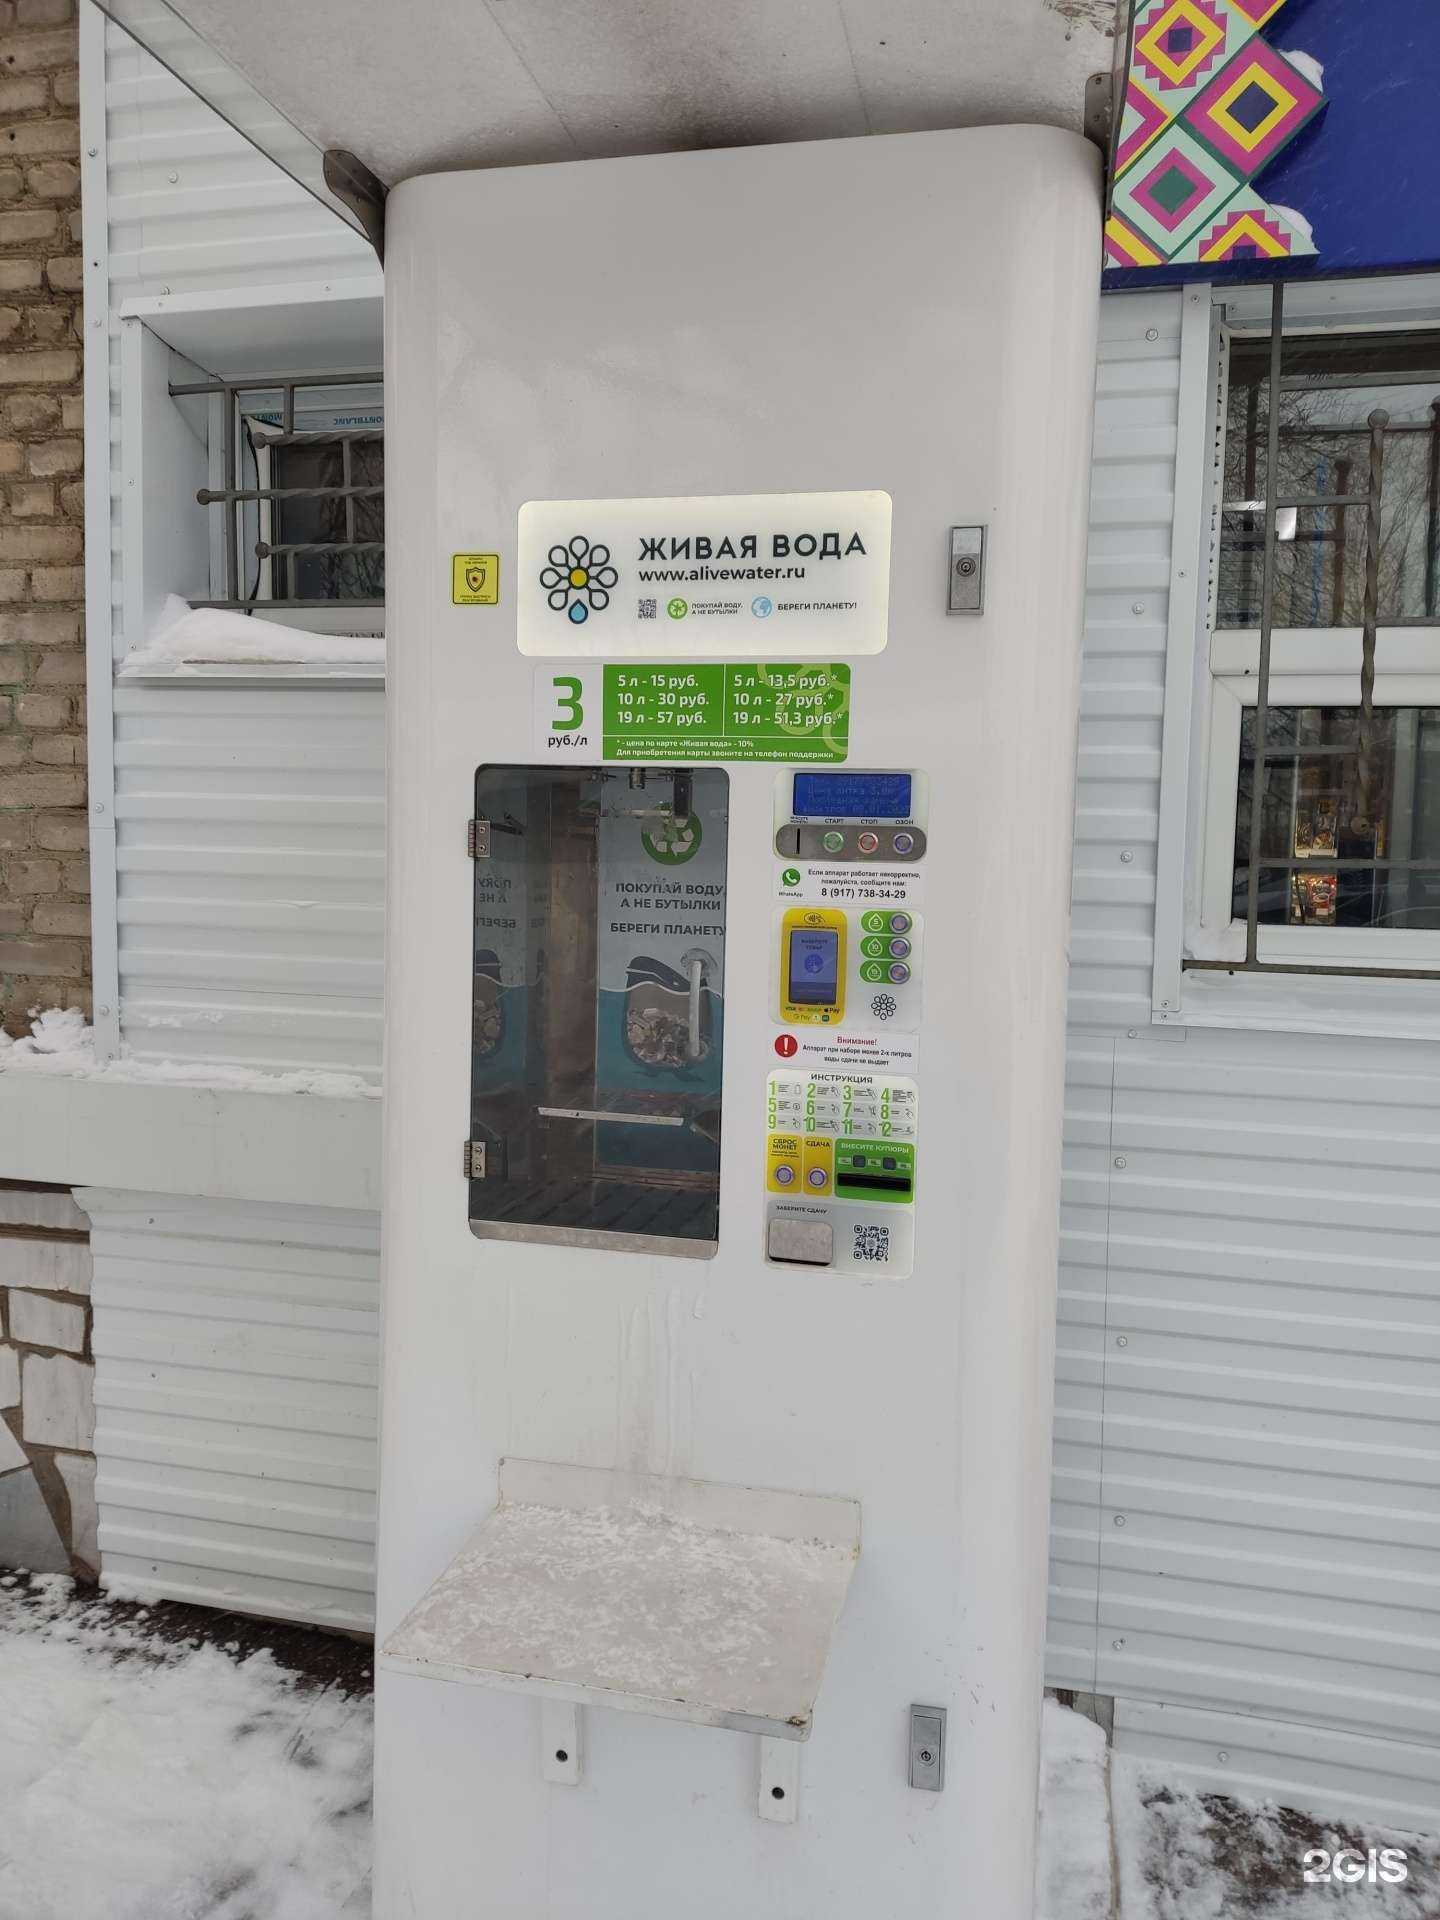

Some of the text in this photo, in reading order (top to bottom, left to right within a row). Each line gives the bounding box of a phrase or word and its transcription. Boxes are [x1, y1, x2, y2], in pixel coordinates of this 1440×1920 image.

[335, 416, 384, 425] ONTBLANC
[638, 532, 867, 561] ЖИВАЯ ВОДА
[638, 565, 805, 582] www.alivewater.ru
[778, 602, 857, 611] БЕРЕГИ ПЛАНЕТУ!
[618, 675, 626, 687] 5
[629, 678, 638, 687] л
[651, 675, 665, 687] 15
[669, 674, 698, 689] руб.
[734, 675, 742, 686] 5
[746, 677, 755, 686] л
[768, 675, 796, 688] 13,5
[552, 676, 584, 730] 3
[618, 693, 633, 705] 10
[637, 696, 645, 705] л
[658, 693, 675, 705] 30
[680, 693, 709, 708] руб.
[734, 693, 749, 705] 10
[753, 696, 761, 705] л
[775, 693, 792, 705] 27
[618, 712, 632, 723] 19
[635, 714, 644, 723] л
[657, 712, 673, 723] 57
[676, 711, 706, 726] руб.
[733, 712, 748, 723] 19
[752, 714, 760, 723] л
[774, 712, 801, 726] 51,3
[548, 735, 588, 747] руб./л
[626, 740, 644, 748] цена
[657, 740, 678, 748] карте
[632, 749, 685, 757] приобретения
[850, 869, 878, 877] работает
[616, 881, 681, 894] ПОКУПАЙ
[821, 878, 858, 886] пожалуйста,
[821, 887, 906, 899] 8 (917) 738-34-29
[620, 898, 720, 910] А НЕ БУТЫЛКИ
[610, 922, 660, 933] БЕРЕГИ
[837, 1036, 877, 1046] Внимание!
[803, 1044, 826, 1052] Аппарат
[840, 1047, 860, 1055] наборе
[811, 1073, 872, 1084] ИНСТРУКЦИЯ
[768, 1080, 775, 1095] 1
[808, 1083, 816, 1098] 2
[843, 1085, 851, 1100] 3
[881, 1088, 889, 1103] 4
[768, 1098, 776, 1112] 5
[807, 1100, 814, 1115] 6
[843, 1102, 852, 1118] 7
[881, 1104, 889, 1120] 8
[768, 1114, 776, 1129] 9
[803, 1116, 816, 1132] 10
[842, 1119, 852, 1134] 11
[878, 1121, 892, 1137] 12
[806, 1140, 830, 1148] СДАЧА
[841, 1143, 909, 1153] ВНЕСИТЕ КУПЮРЫ
